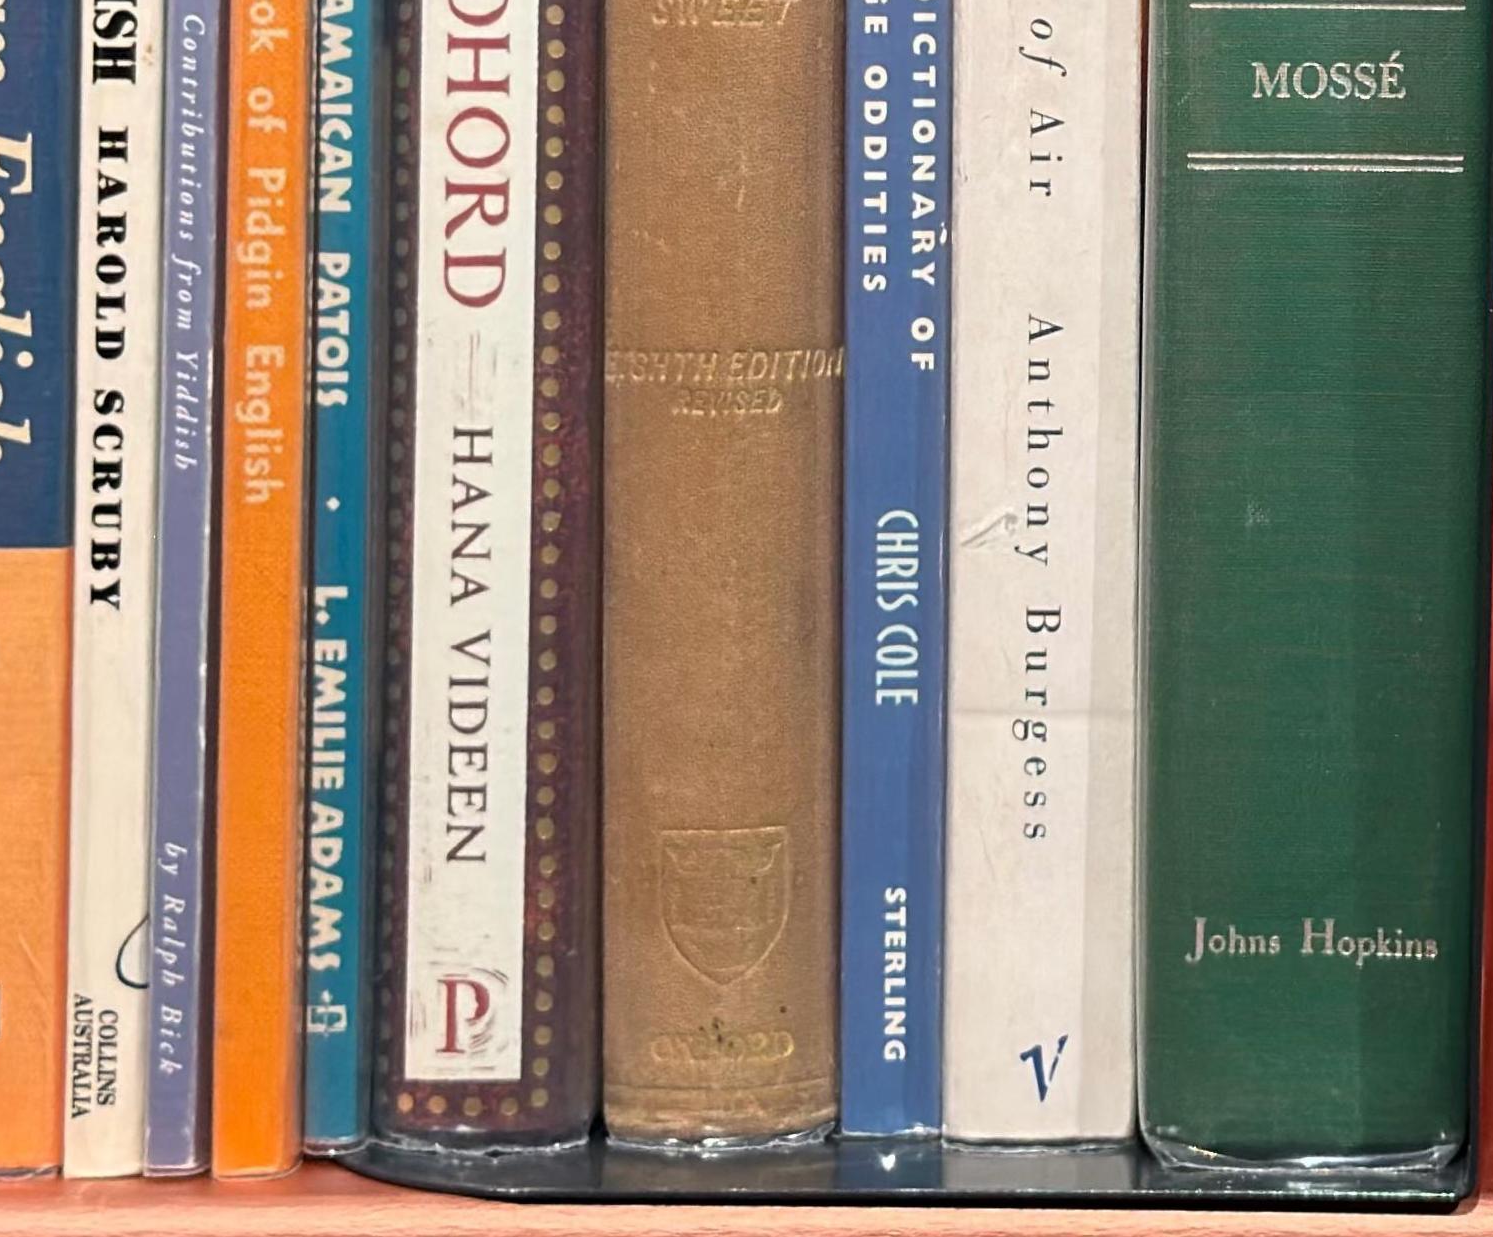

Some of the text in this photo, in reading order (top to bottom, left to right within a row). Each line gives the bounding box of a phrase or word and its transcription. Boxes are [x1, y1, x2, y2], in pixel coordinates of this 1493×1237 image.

[247, 87, 287, 134] of
[1019, 15, 1065, 67] of
[1250, 56, 1405, 99] MOSSÉ
[178, 14, 205, 242] Contributions
[860, 62, 890, 294] ODDITIES
[1029, 106, 1065, 196] Air
[93, 128, 129, 362] HAROLD
[172, 251, 201, 331] from
[238, 167, 286, 309] Pidgin
[316, 251, 350, 408] PATOIS
[911, 317, 935, 373] OF
[174, 350, 199, 471] Yiddish
[234, 345, 286, 504] English
[89, 388, 125, 612] SCRUBY
[1012, 313, 1063, 842] Anthony Burgess
[445, 426, 493, 866] HANA VIDEEN
[874, 509, 919, 707] CHRIS COLE
[312, 585, 348, 972] L. EMILIE ADAMS
[155, 842, 187, 1075] by Ralph Bick
[883, 887, 907, 1062] STERLING
[1185, 917, 1438, 968] Johns Hopkins
[71, 993, 93, 1119] AUSTRALIA
[97, 1009, 118, 1106] COLLINS
